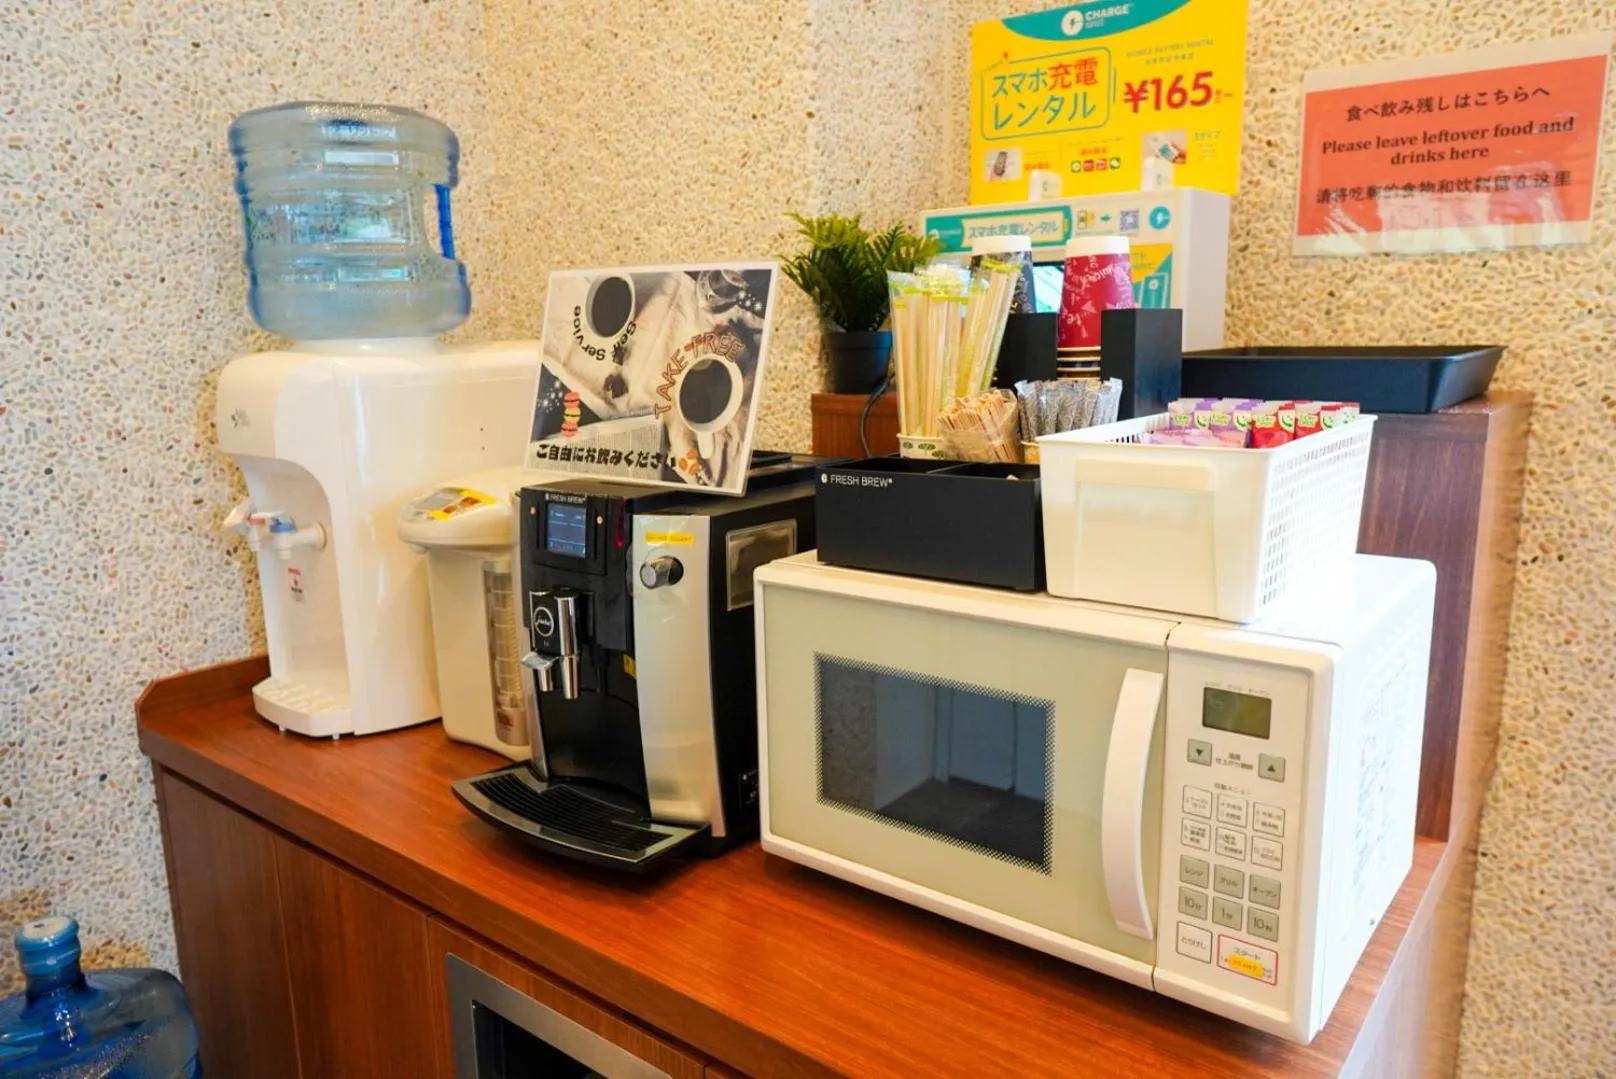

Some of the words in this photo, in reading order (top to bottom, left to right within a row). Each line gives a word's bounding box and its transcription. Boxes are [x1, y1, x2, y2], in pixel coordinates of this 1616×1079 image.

[992, 57, 1098, 98] スマホ充電
[1123, 70, 1214, 113] ¥165
[994, 90, 1097, 130] レンタル
[1346, 86, 1550, 122] 食べ飲み残しはこちらへ
[1322, 138, 1372, 155] Please
[1376, 134, 1418, 150] leave
[1422, 126, 1489, 145] leftover
[1493, 119, 1533, 138] food
[1536, 116, 1575, 133] and
[1390, 150, 1446, 166] drinks
[1449, 145, 1489, 160] here
[573, 305, 606, 361] Service
[655, 348, 689, 419] TAKE
[691, 332, 745, 363] FREE
[536, 443, 677, 469] ご自由にお飲みください
[829, 474, 860, 485] FRESH
